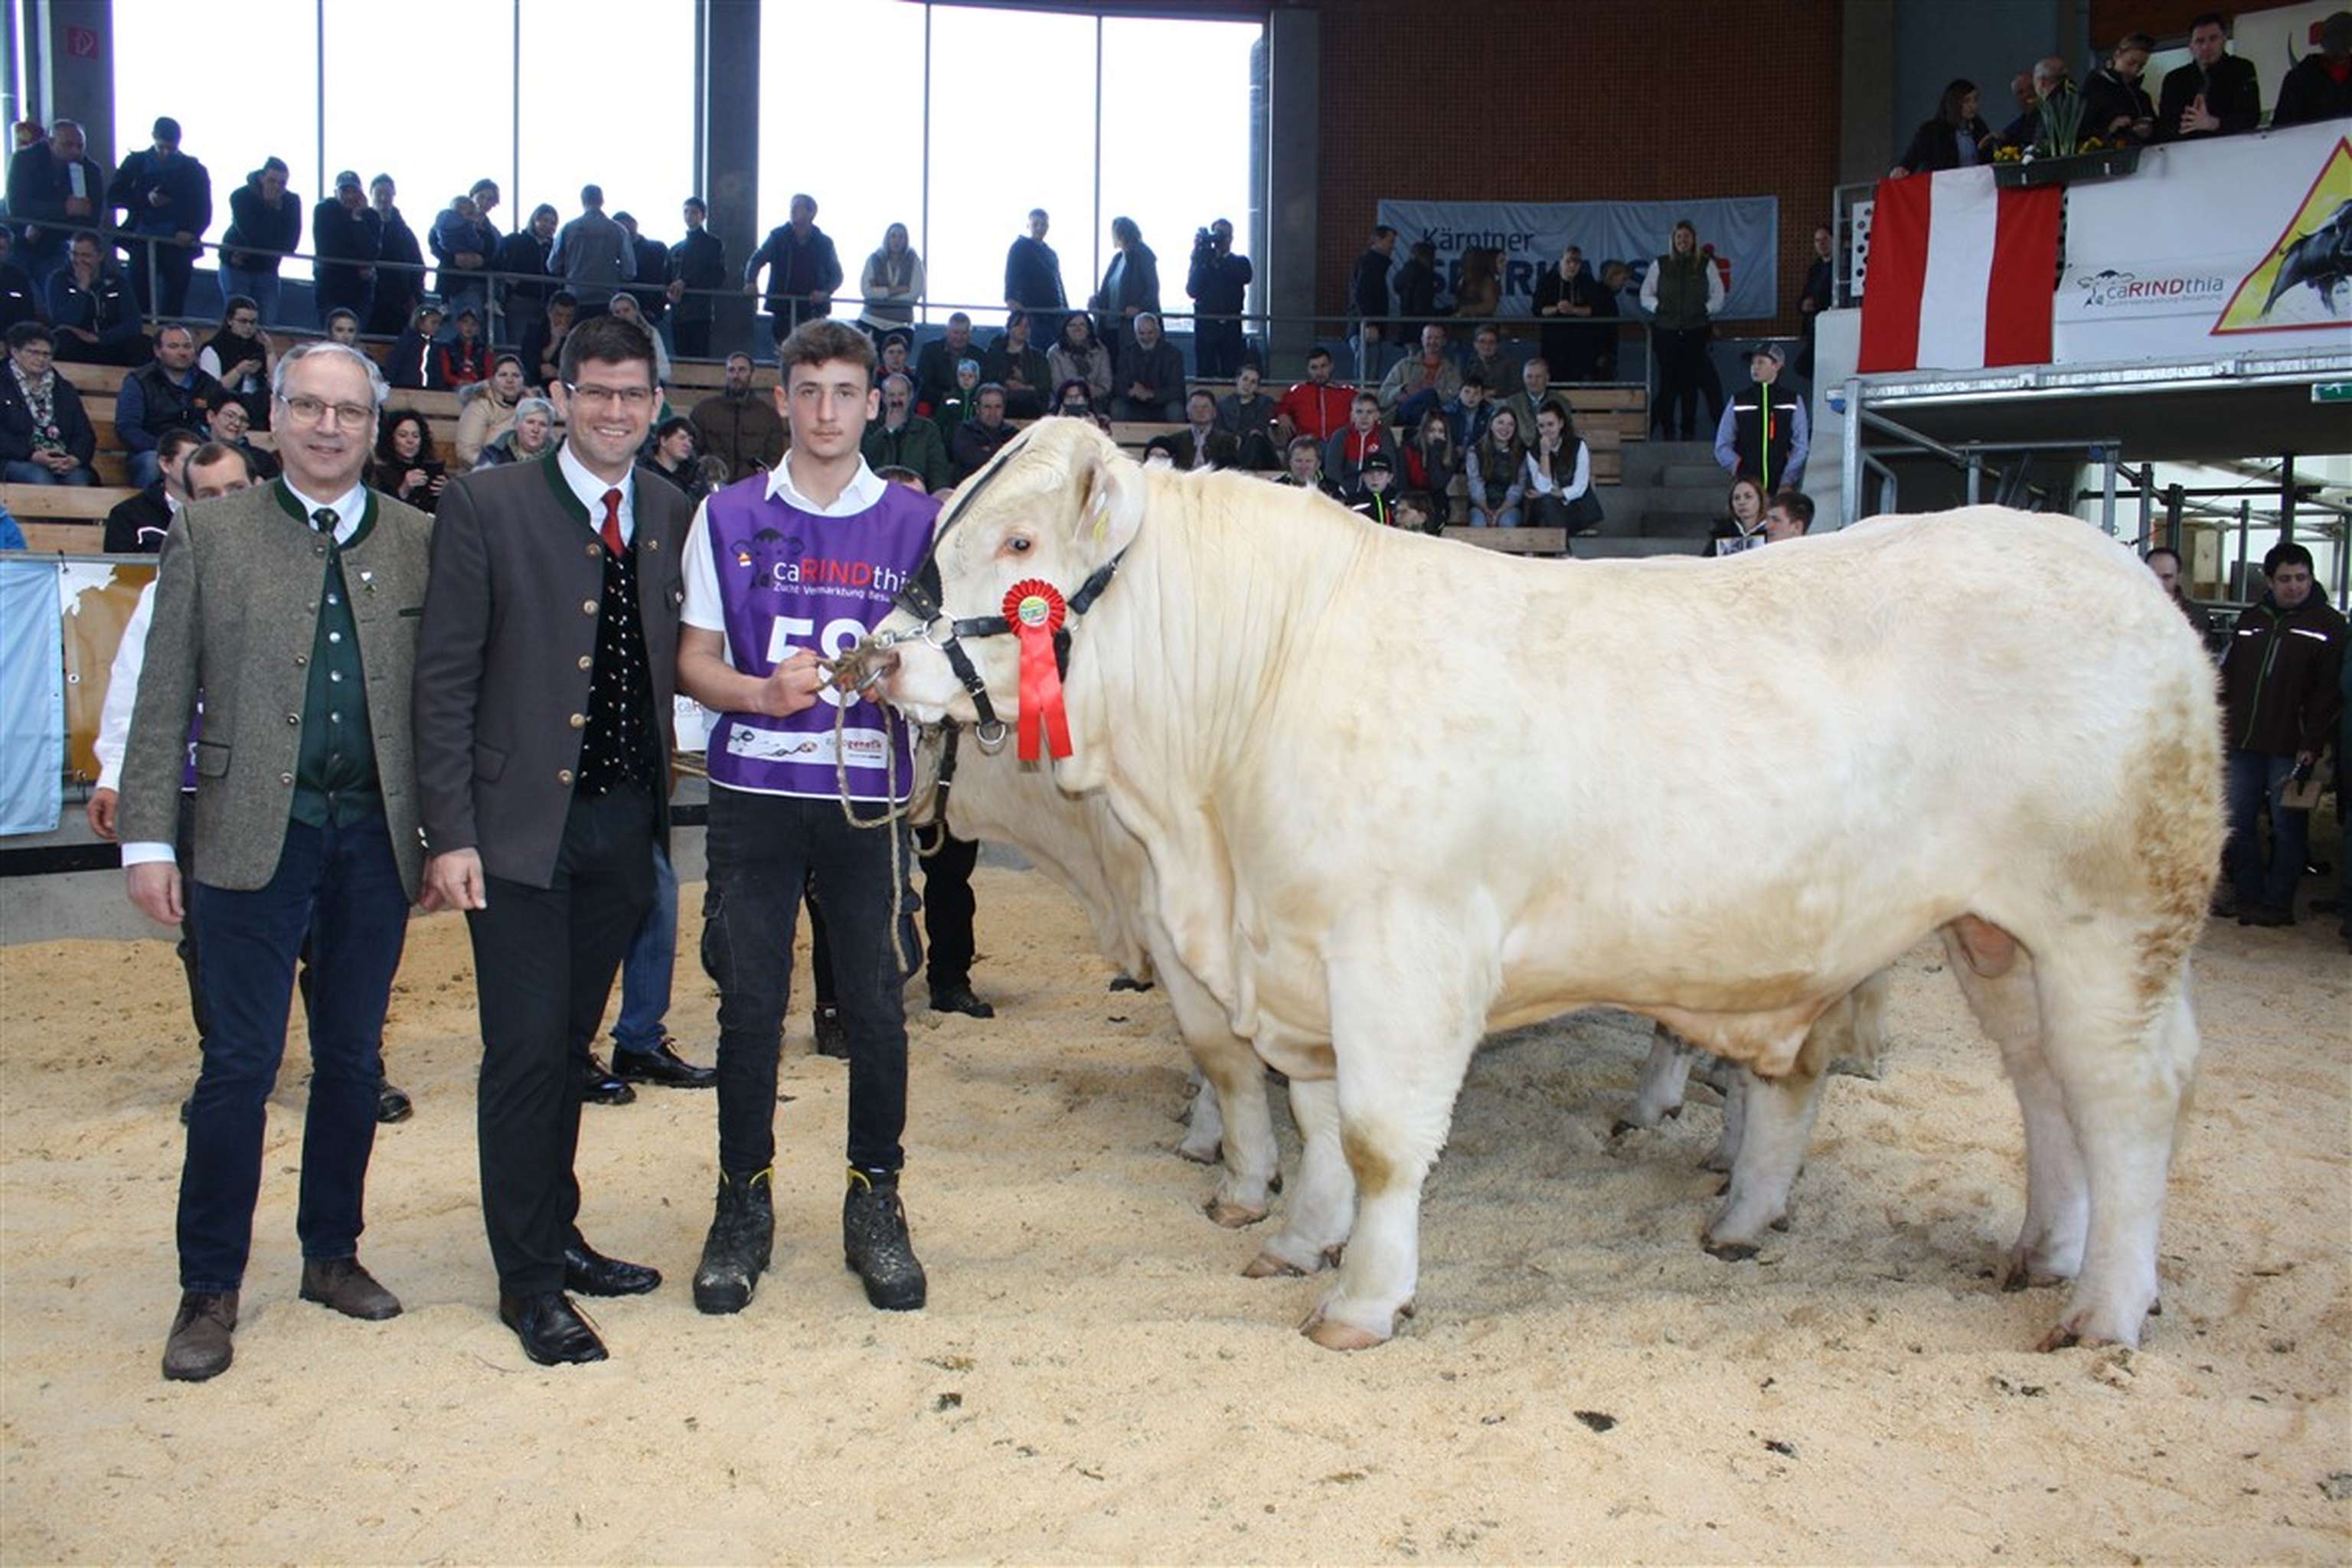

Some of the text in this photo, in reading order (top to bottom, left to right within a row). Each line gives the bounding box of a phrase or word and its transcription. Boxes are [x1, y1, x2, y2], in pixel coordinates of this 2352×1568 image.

[1423, 227, 1535, 252] Kärntner
[2106, 277, 2223, 299] caRINDthia
[773, 558, 910, 593] caRINDthi
